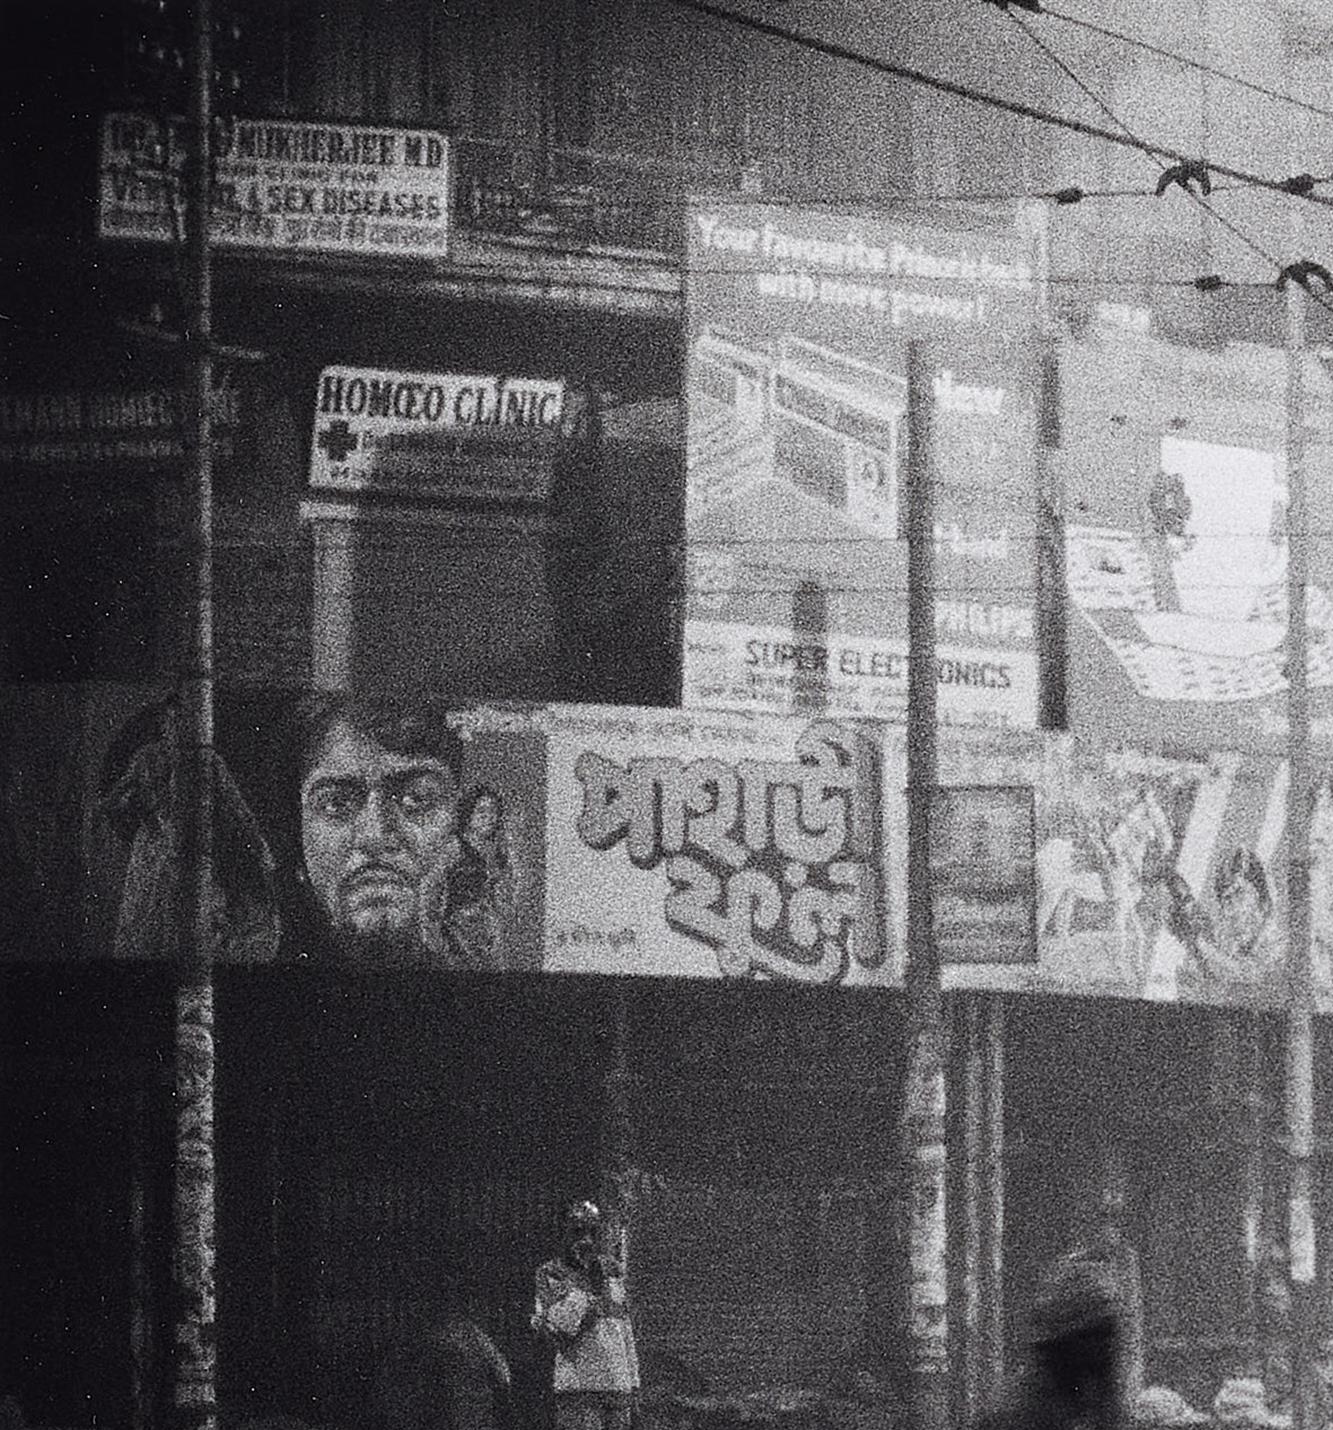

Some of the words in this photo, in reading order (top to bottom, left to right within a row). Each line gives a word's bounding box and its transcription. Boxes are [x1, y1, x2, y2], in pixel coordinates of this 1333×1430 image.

[267, 185, 314, 214] SEX
[322, 188, 441, 220] DISEASES
[453, 386, 556, 427] CLINIC
[744, 640, 828, 672] SUPER
[838, 649, 1012, 690] ELECONICS
